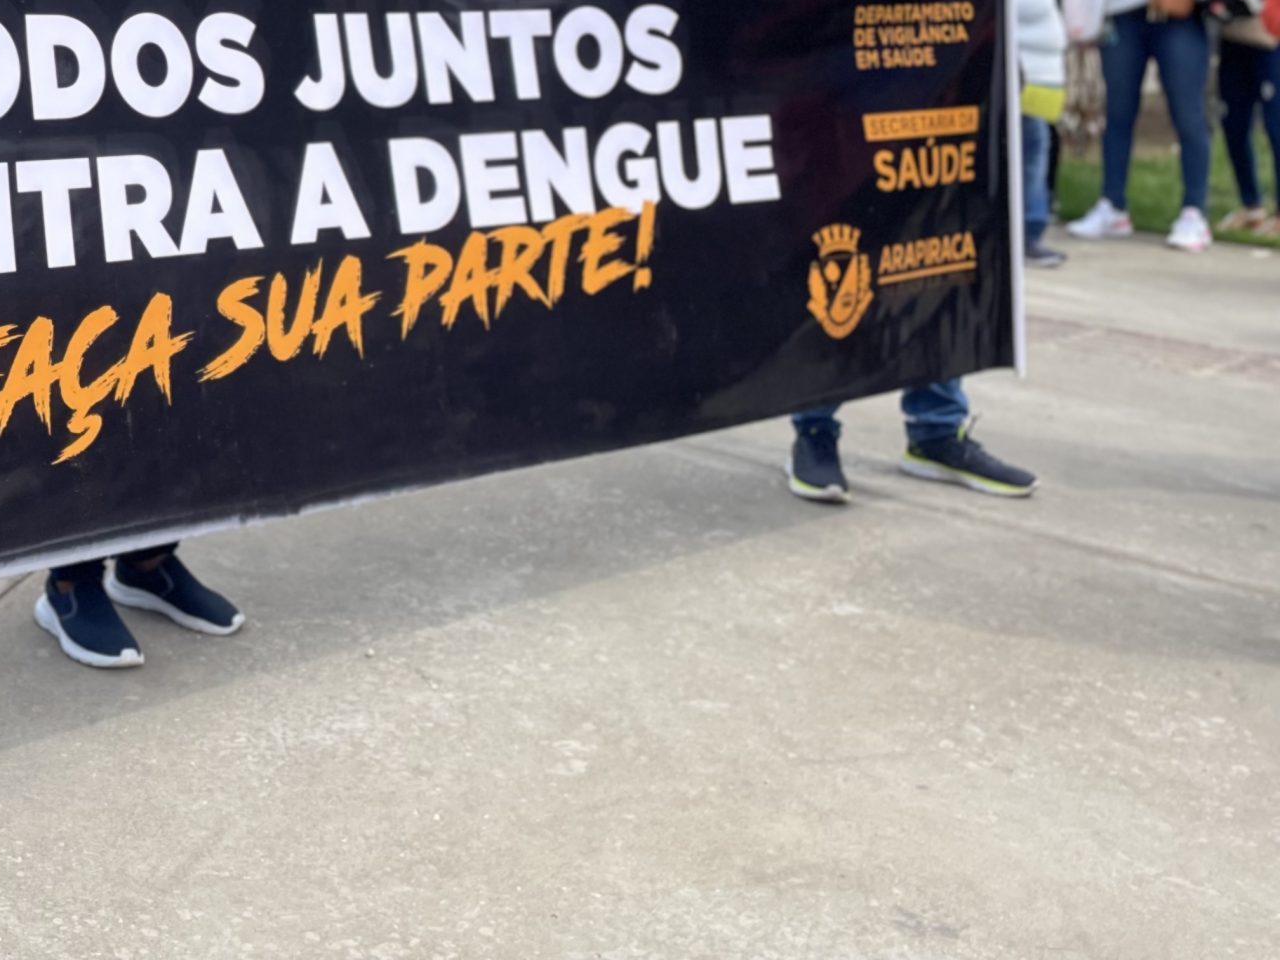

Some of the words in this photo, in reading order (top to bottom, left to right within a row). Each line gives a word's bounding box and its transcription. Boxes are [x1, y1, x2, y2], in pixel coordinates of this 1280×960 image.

[853, 27, 876, 47] DE
[854, 1, 975, 25] DEPARTAMENTO
[294, 4, 683, 111] JUNTOS
[855, 49, 880, 70] EM
[290, 142, 372, 245] A
[388, 115, 782, 235] DENGUE
[873, 136, 977, 192] SAÚDE
[878, 231, 977, 274] ARAPIRACA
[197, 255, 382, 383] SUA
[385, 199, 656, 341] PARTE!
